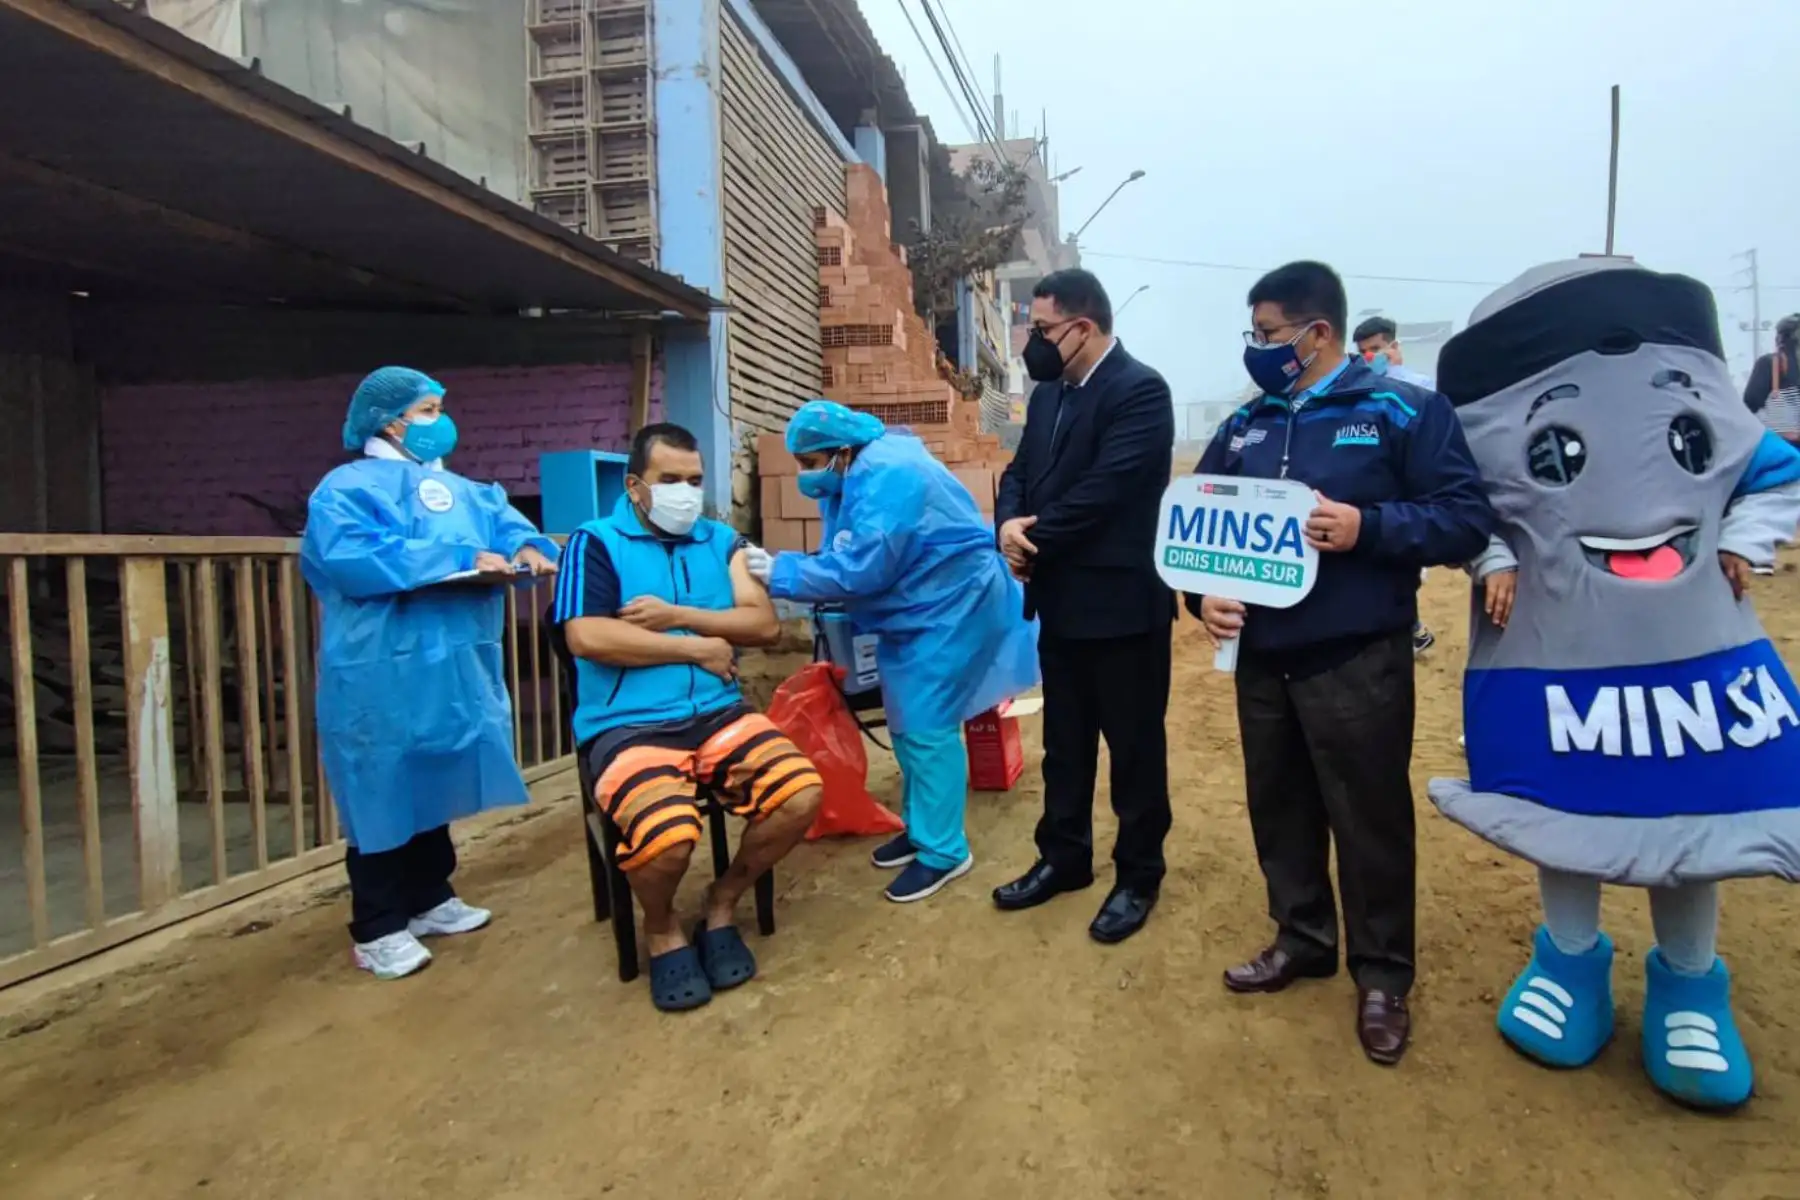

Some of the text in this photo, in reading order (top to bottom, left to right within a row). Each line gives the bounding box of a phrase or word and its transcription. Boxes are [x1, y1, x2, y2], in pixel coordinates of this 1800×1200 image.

[1168, 504, 1305, 559] MINSA
[1168, 549, 1298, 585] DIRIS LIMA SUR
[1544, 664, 1800, 758] MINSA
